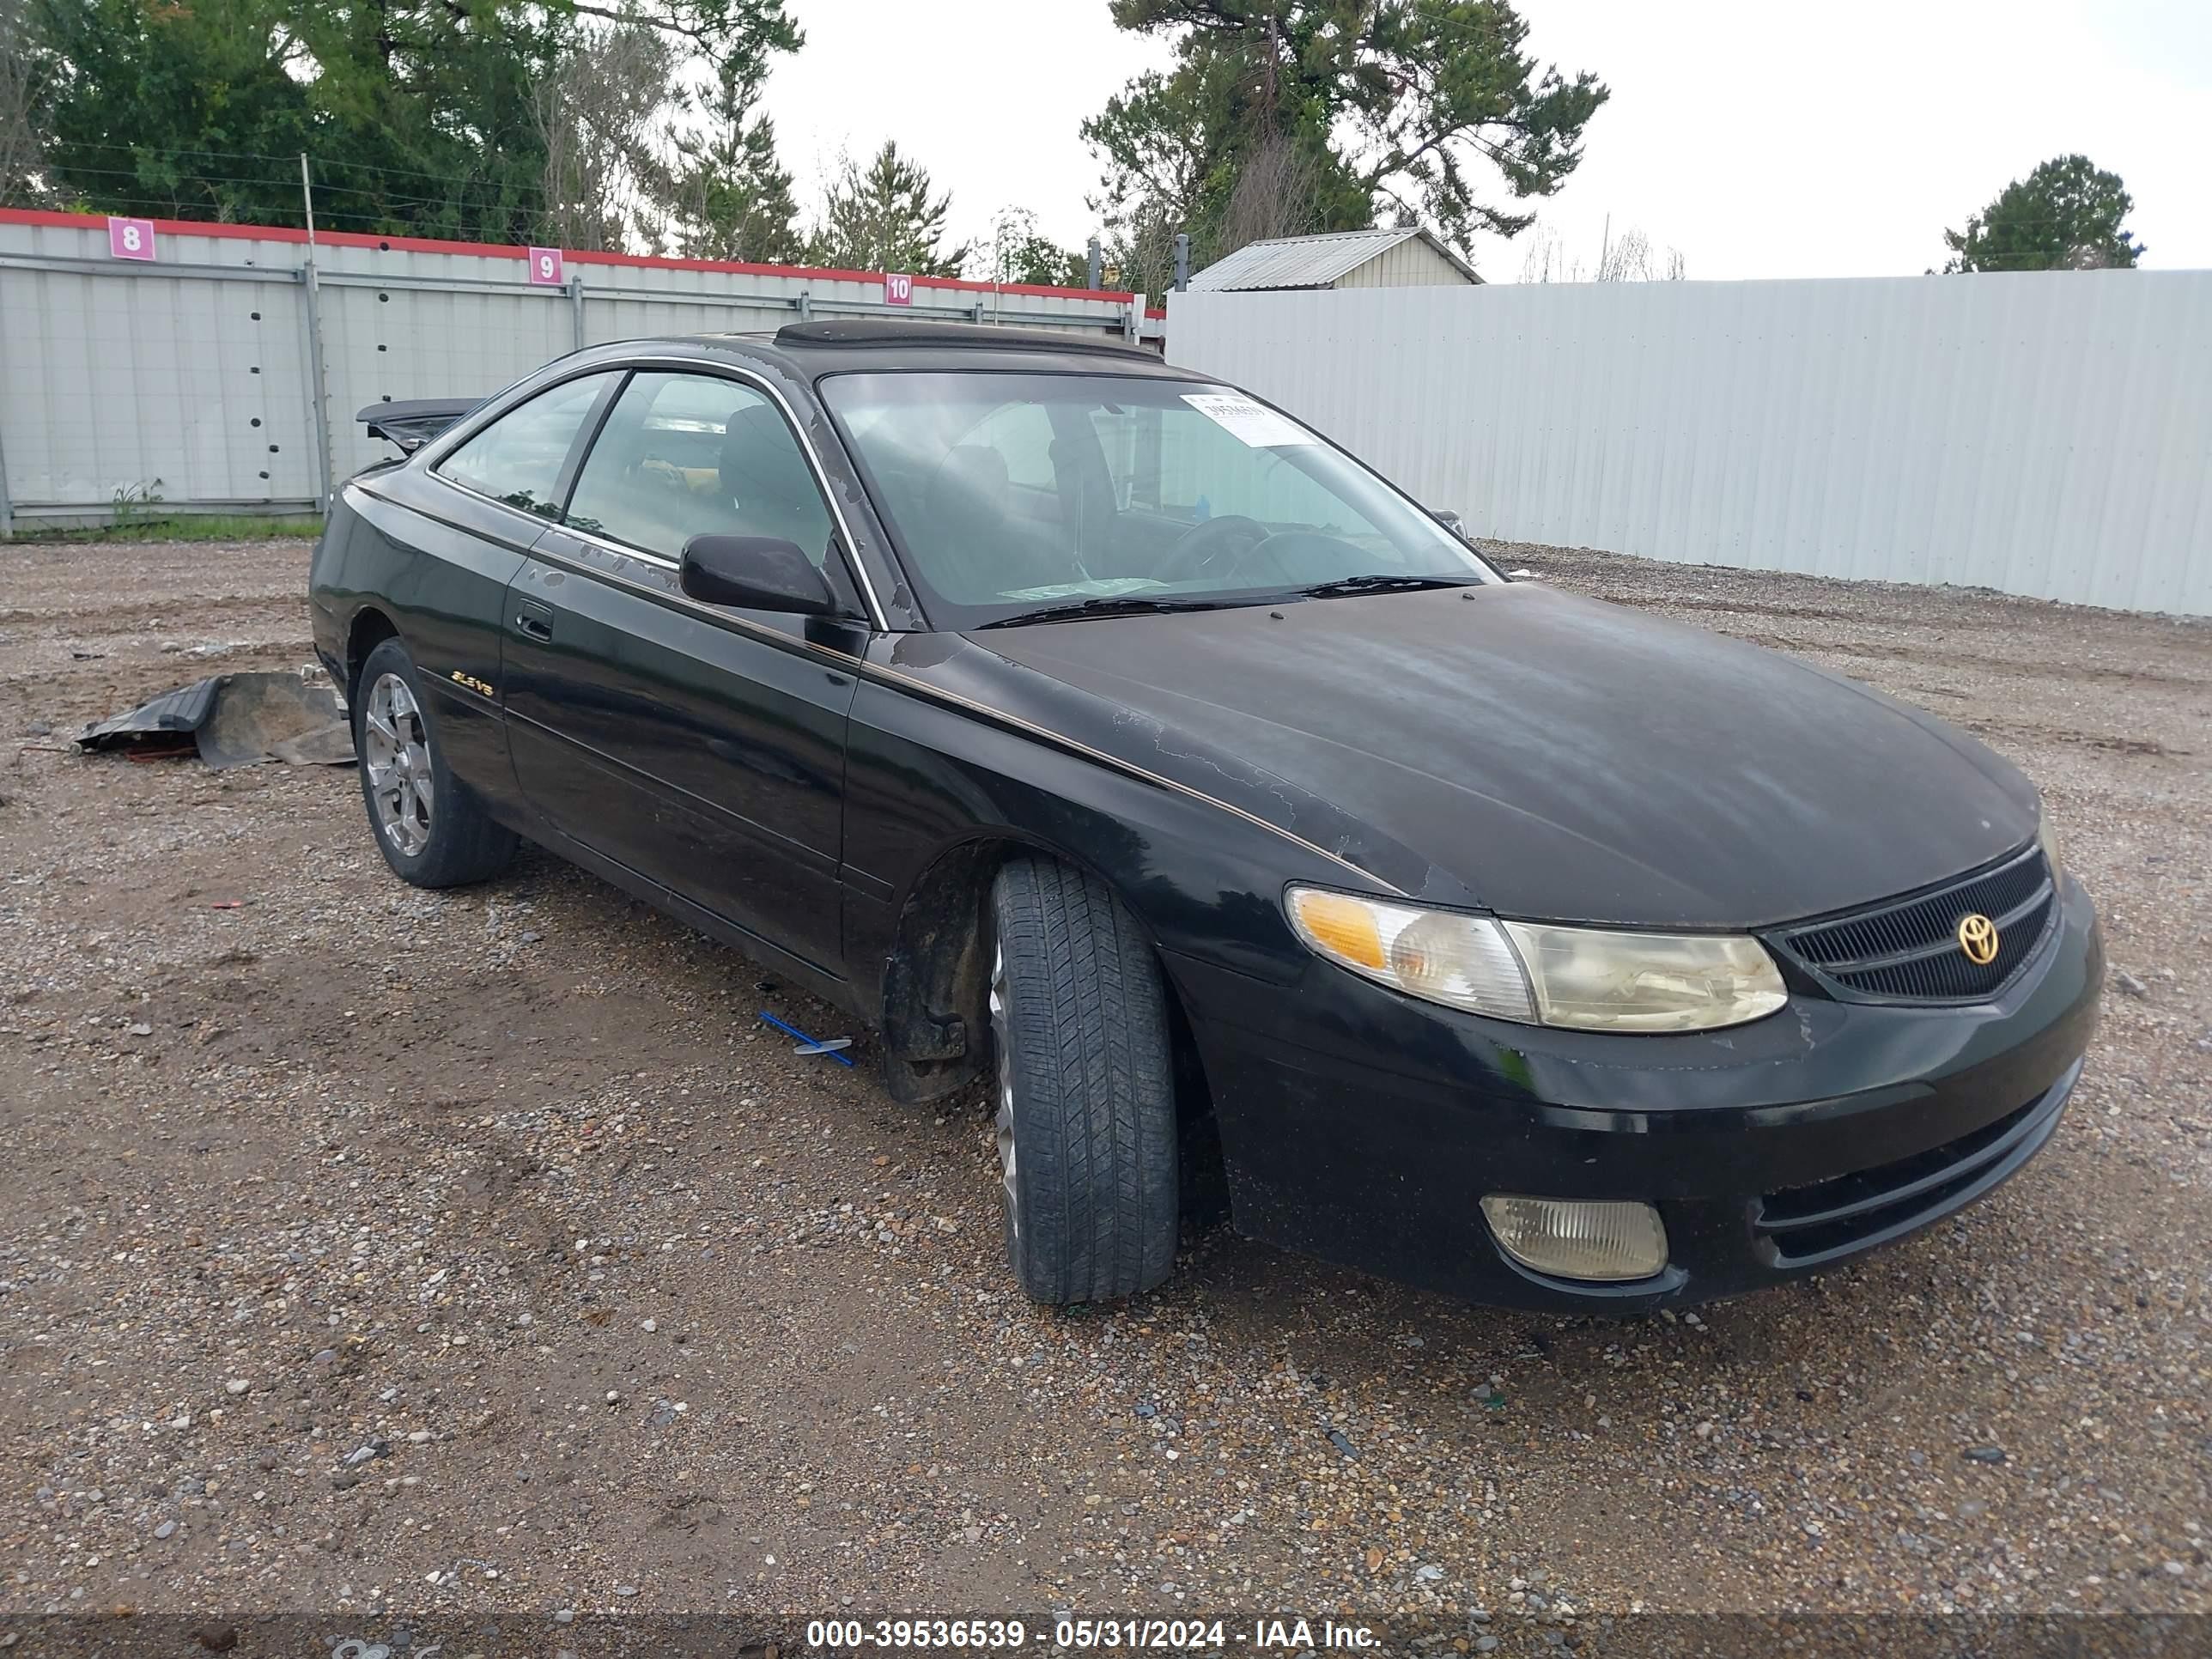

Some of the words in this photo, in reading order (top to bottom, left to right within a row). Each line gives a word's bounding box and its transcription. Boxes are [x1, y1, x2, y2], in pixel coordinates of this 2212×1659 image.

[124, 226, 141, 252] 8
[539, 255, 555, 279] 9
[890, 278, 909, 301] 10
